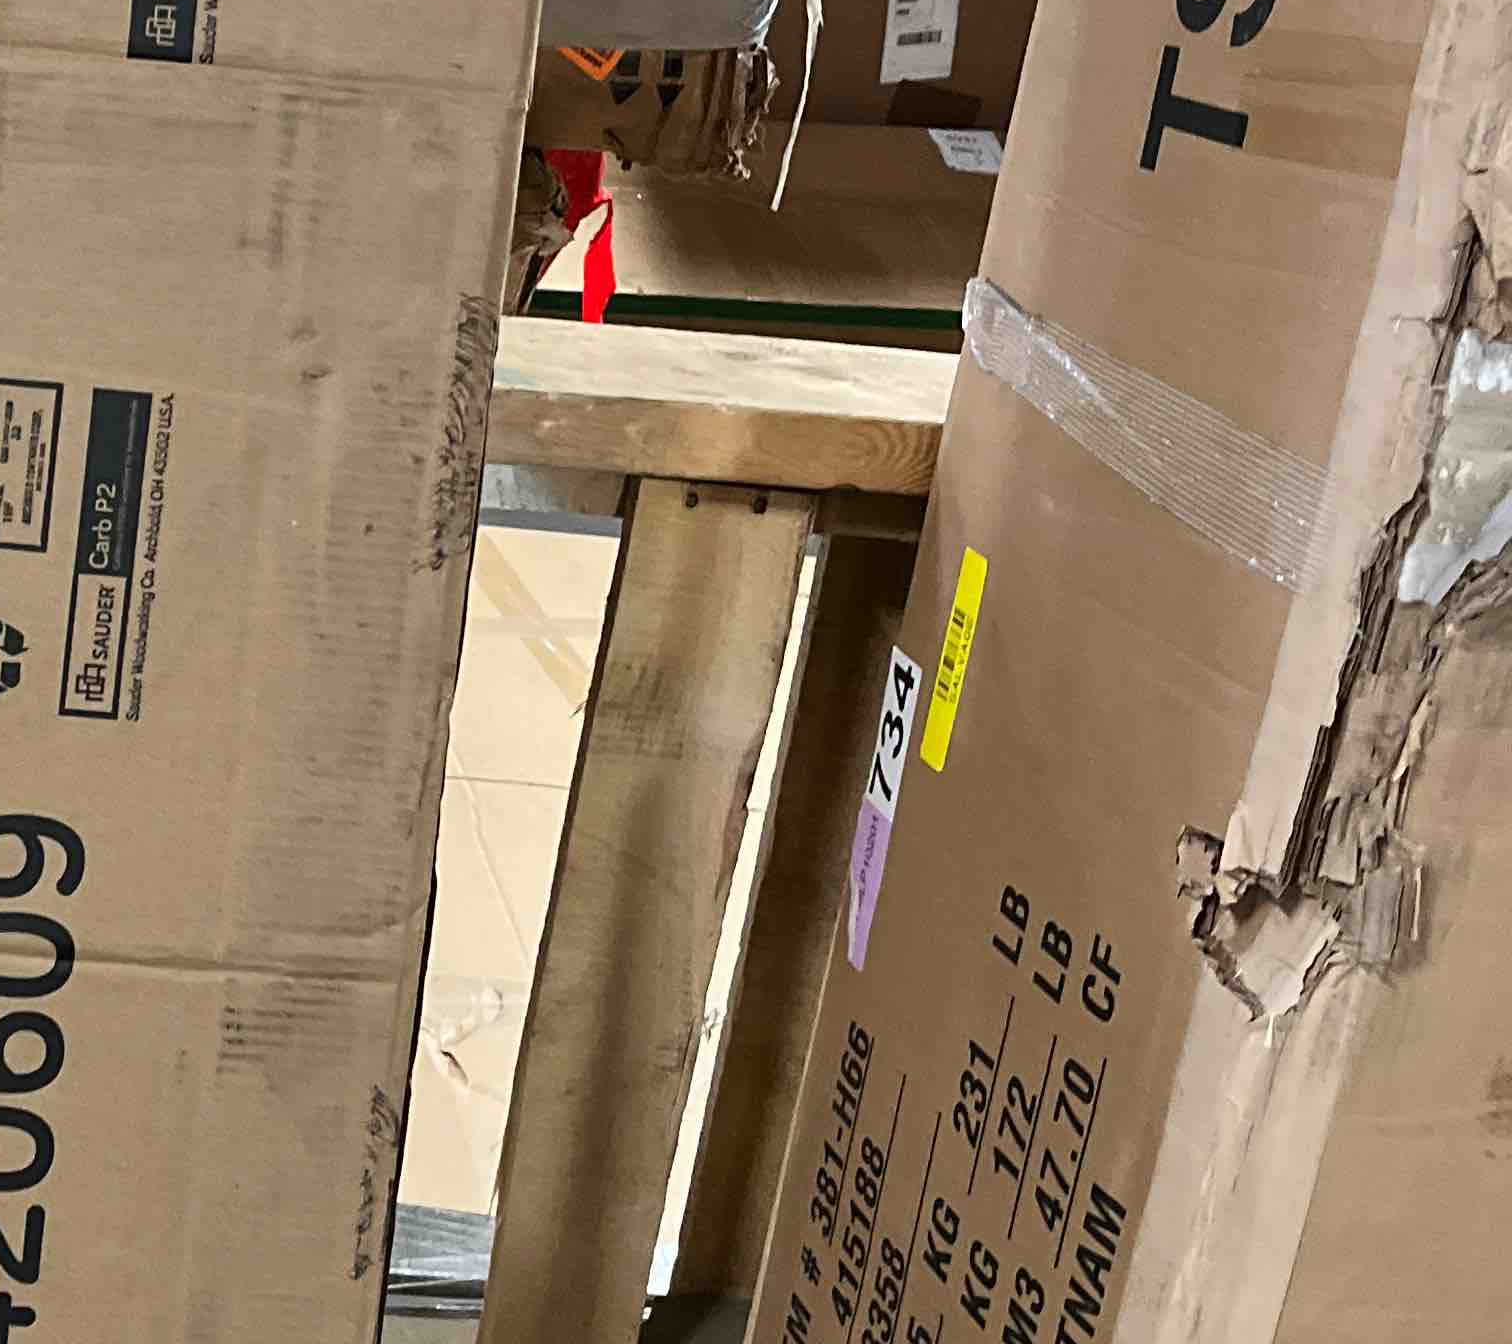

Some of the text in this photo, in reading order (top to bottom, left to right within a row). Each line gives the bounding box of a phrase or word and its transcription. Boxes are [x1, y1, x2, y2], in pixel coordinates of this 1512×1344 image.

[199, 15, 217, 65] Sauder
[150, 479, 165, 502] OH
[154, 432, 170, 477] 43502
[90, 483, 116, 570] Carb P2
[94, 584, 116, 660] SAUDER
[129, 592, 155, 675] Woodworking
[126, 678, 144, 723] Sauder
[869, 662, 915, 802] 734
[923, 1196, 960, 1285] KG
[953, 1039, 997, 1150] 231
[992, 885, 1031, 966] LB
[960, 1239, 1000, 1329] KG
[993, 1074, 1037, 1183] 172
[1032, 920, 1073, 1005] LB
[1034, 1057, 1096, 1233] 47.70
[1081, 934, 1123, 1024] CF
[810, 1020, 871, 1239] 381-H66
[802, 1245, 822, 1287] #
